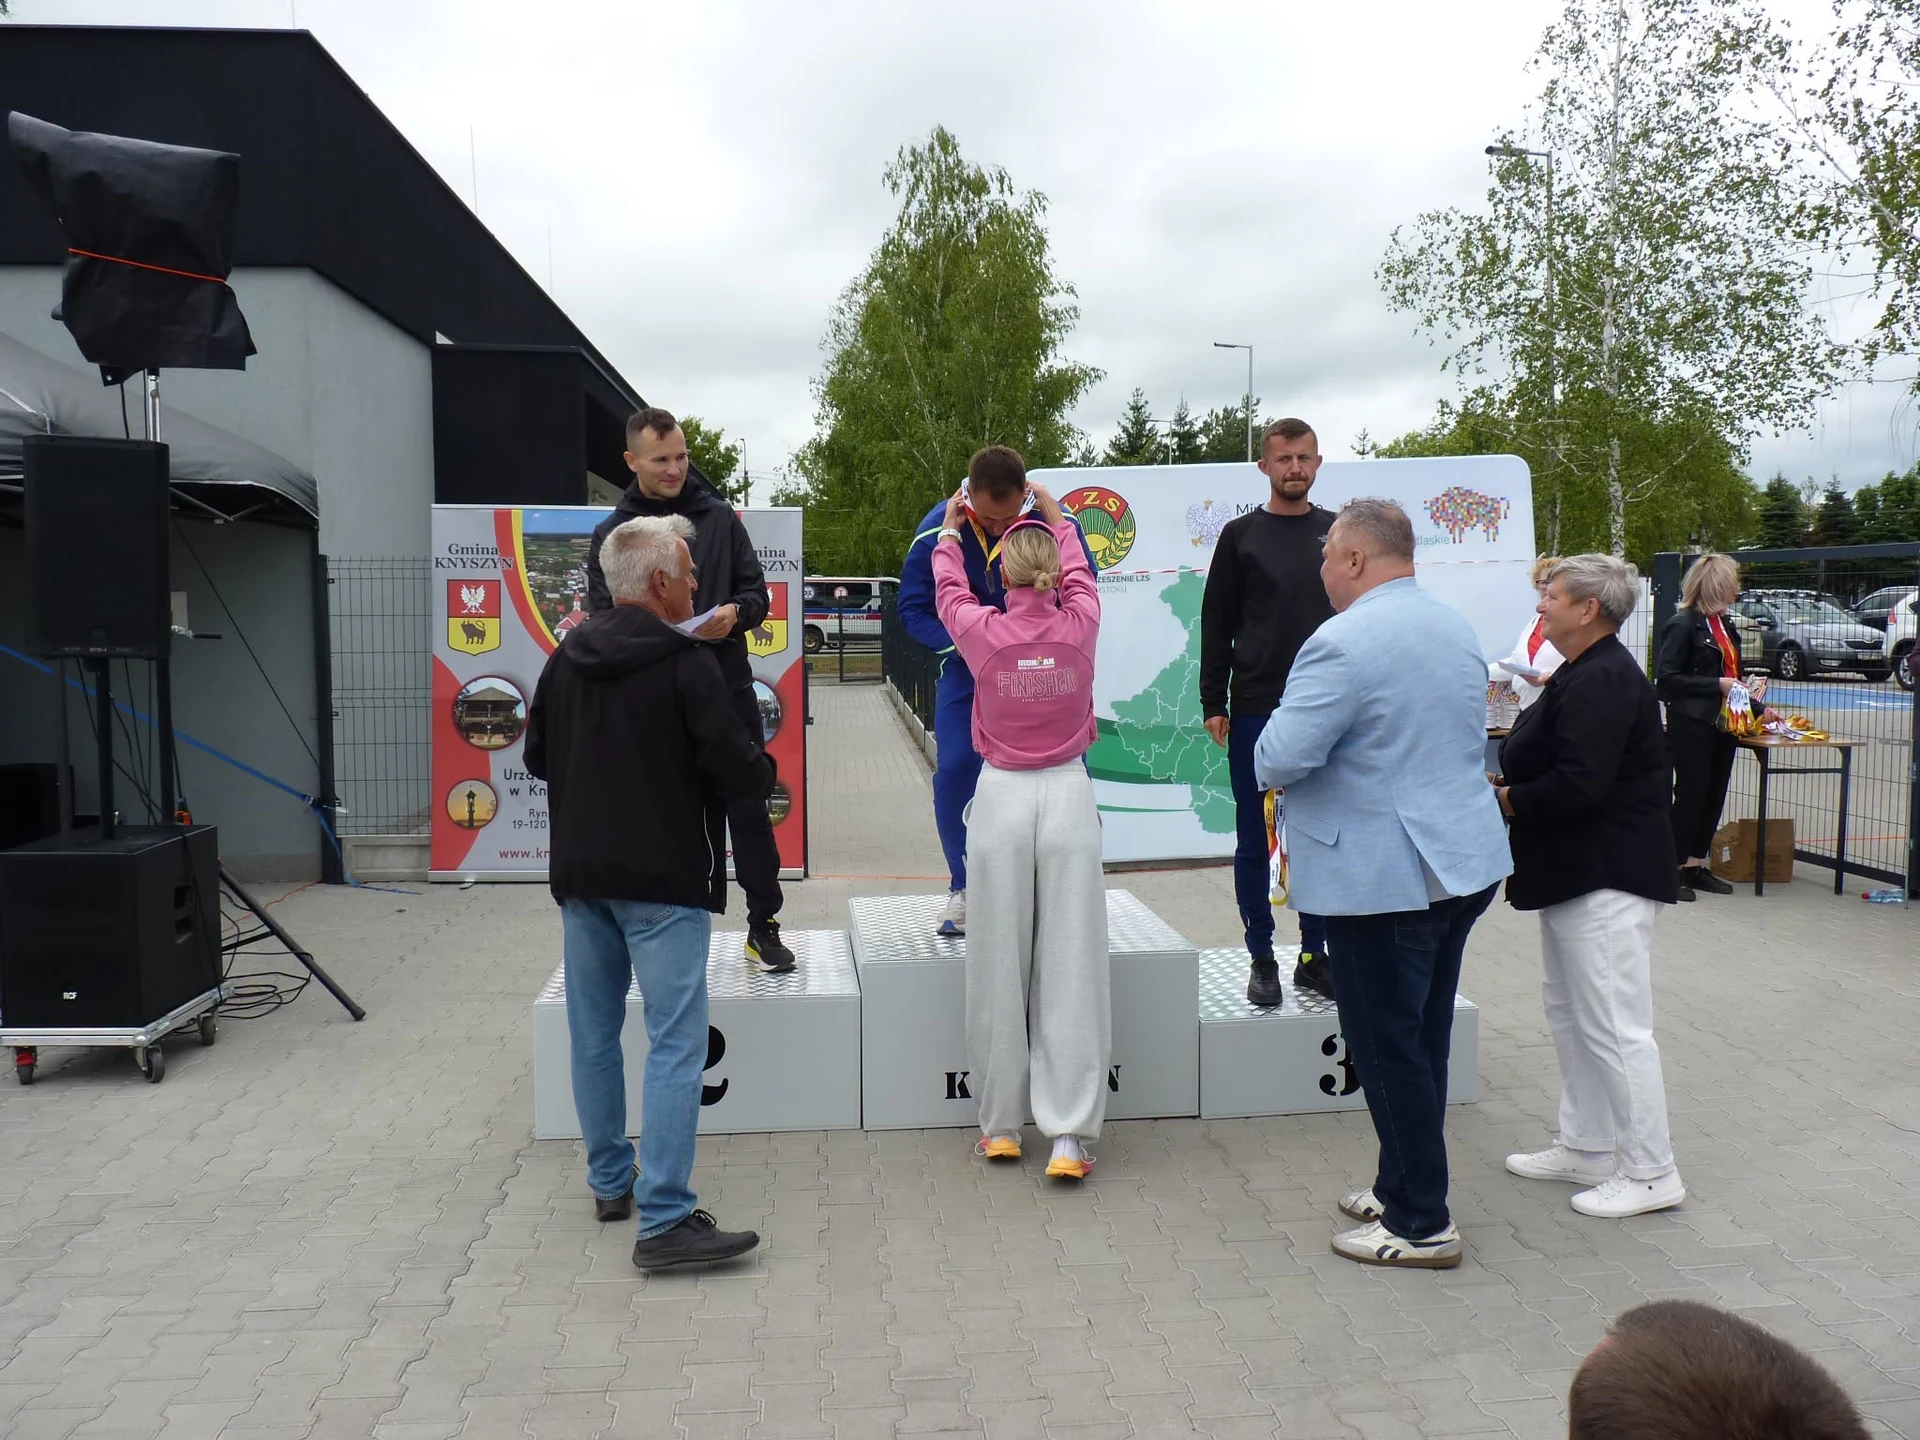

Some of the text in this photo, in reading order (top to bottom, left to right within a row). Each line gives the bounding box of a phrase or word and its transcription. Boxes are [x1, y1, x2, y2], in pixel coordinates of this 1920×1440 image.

[1063, 491, 1120, 514] LZS
[1416, 535, 1450, 545] dlaskie
[448, 543, 499, 555] Gmina
[434, 557, 513, 569] KNYSZYN
[760, 560, 799, 571] SZYN
[1098, 574, 1150, 583] ZESZENIE LZS
[503, 768, 535, 784] Urzą
[509, 784, 547, 796] w Kn
[529, 808, 547, 820] Ryn
[512, 820, 547, 829] 19-120
[63, 991, 78, 1000] RCF
[1319, 1033, 1361, 1096] 3
